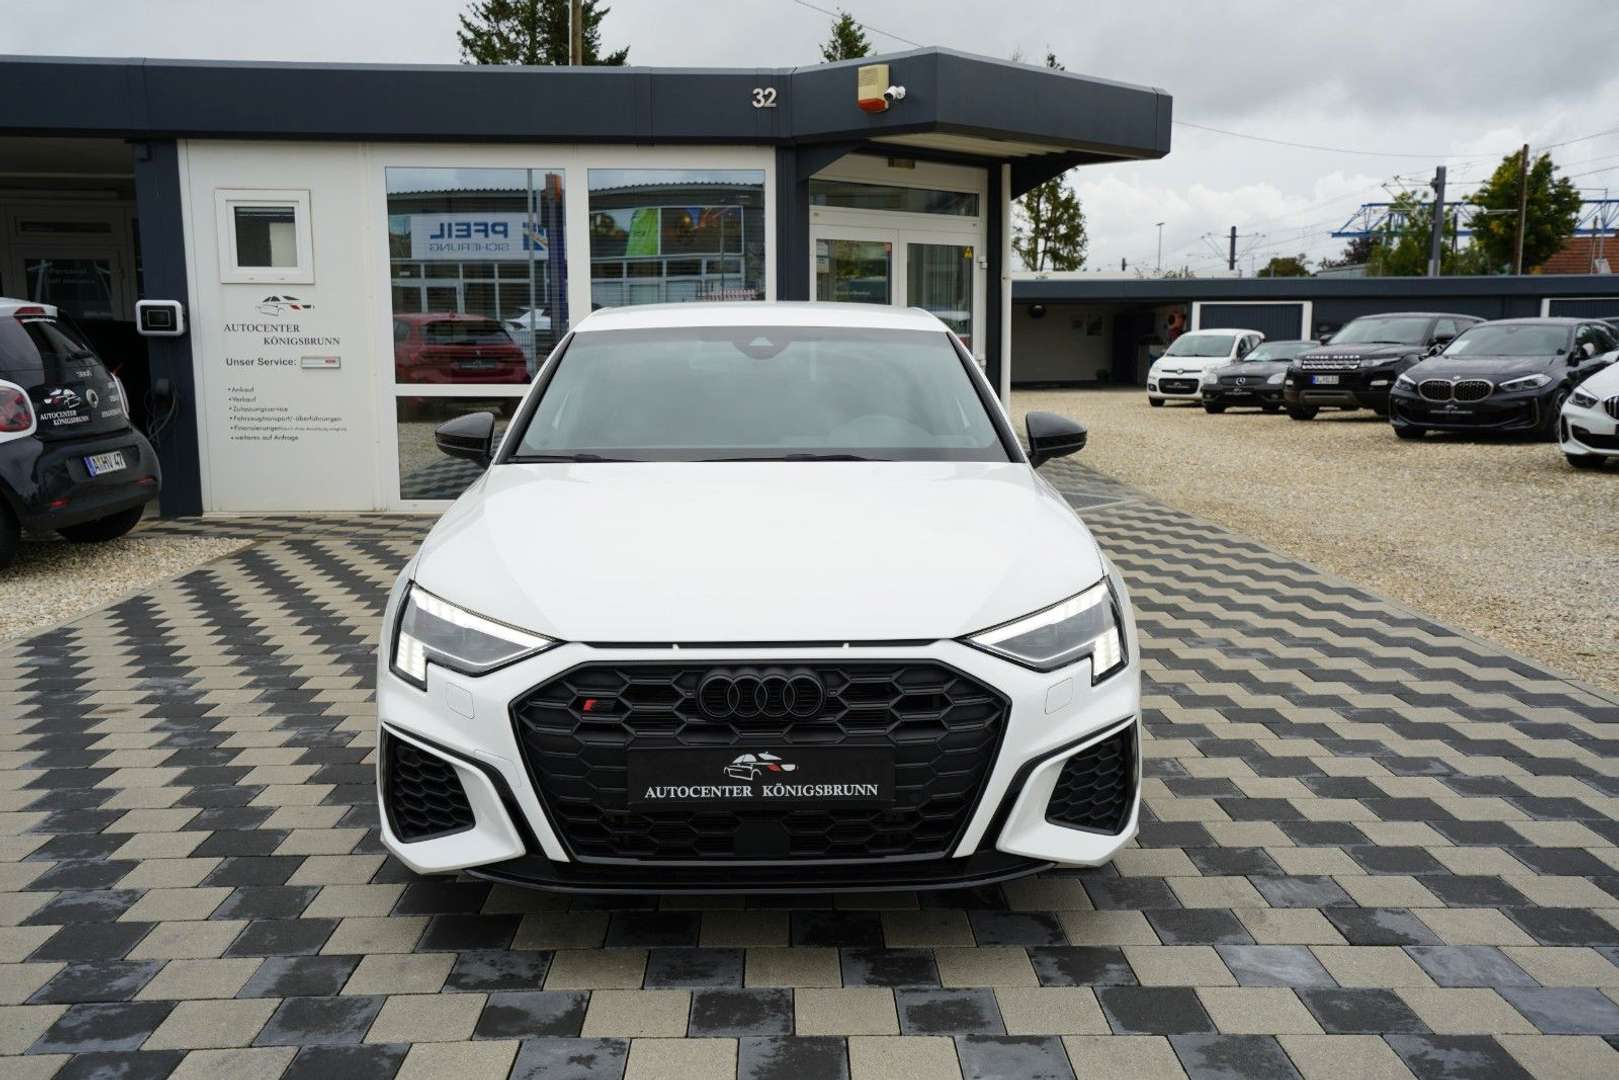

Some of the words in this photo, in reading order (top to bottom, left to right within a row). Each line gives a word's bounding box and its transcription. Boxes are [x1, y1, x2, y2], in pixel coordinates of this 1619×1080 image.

[752, 87, 777, 108] 32
[224, 323, 300, 333] AUTOCENTER
[263, 335, 340, 345] KÖNIGSBRUNN
[226, 358, 254, 366] Unser
[257, 357, 297, 366] Service:
[644, 785, 753, 799] AUTOCENTER
[762, 783, 879, 797] KÖNIGSBRUNN
